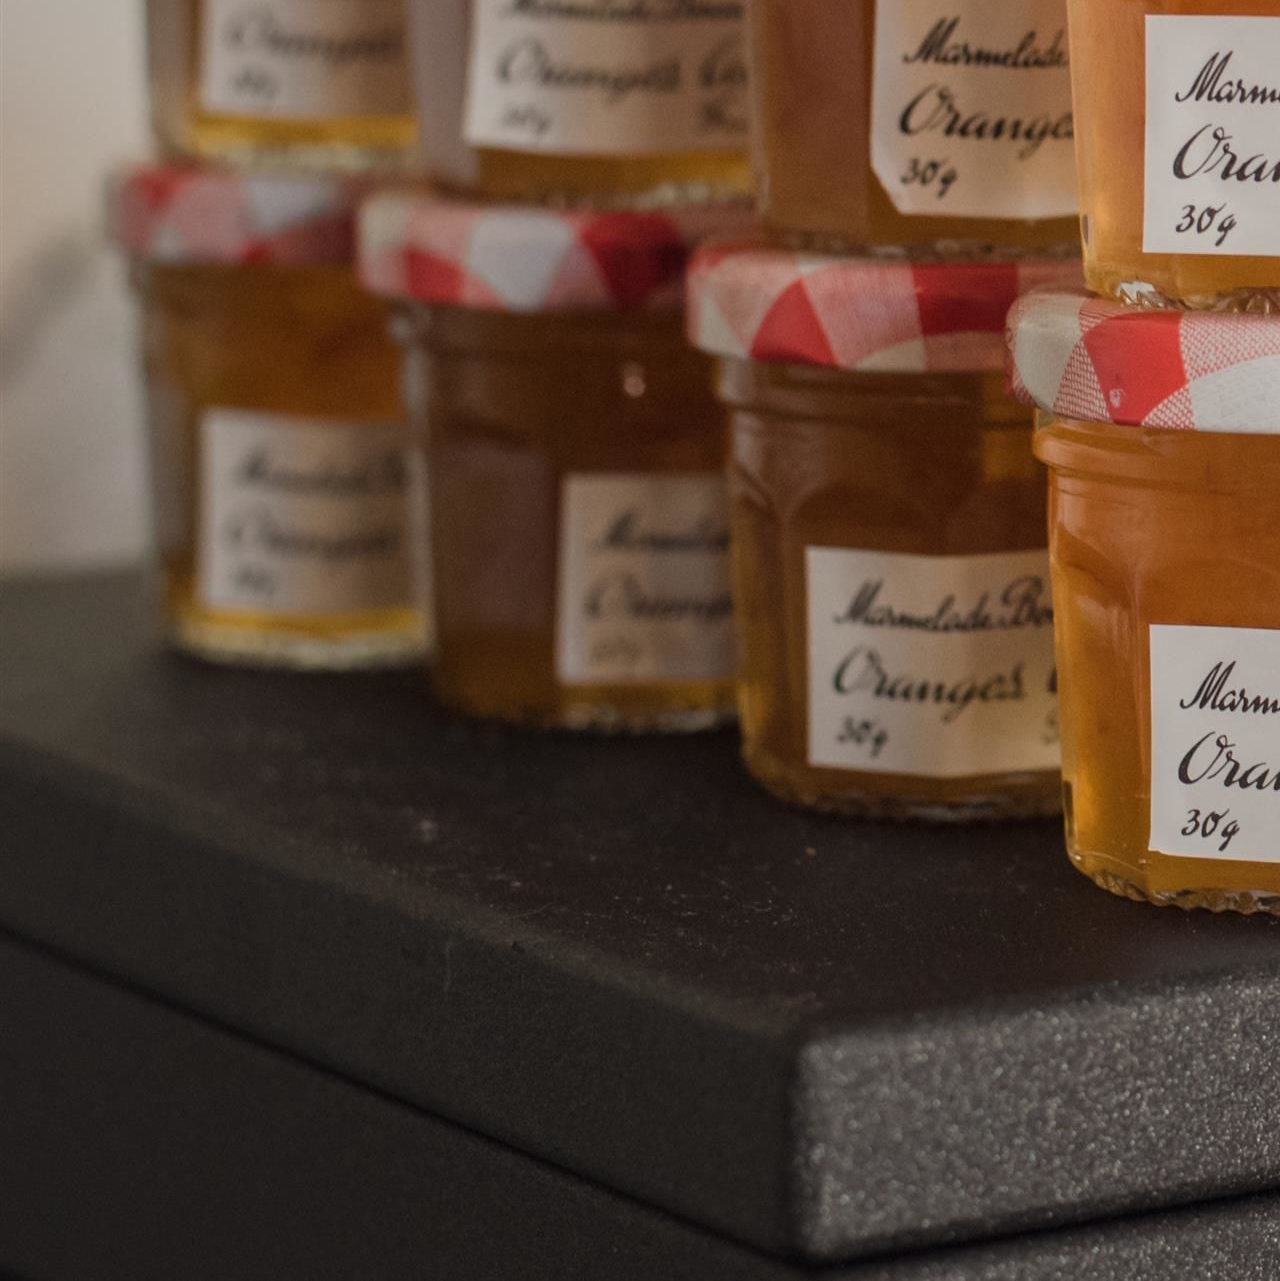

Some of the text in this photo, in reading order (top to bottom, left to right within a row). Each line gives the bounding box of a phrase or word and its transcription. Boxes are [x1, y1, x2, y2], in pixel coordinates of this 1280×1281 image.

[899, 82, 1075, 161] Orange
[1175, 202, 1238, 247] 30g
[1180, 807, 1241, 852] 30g
